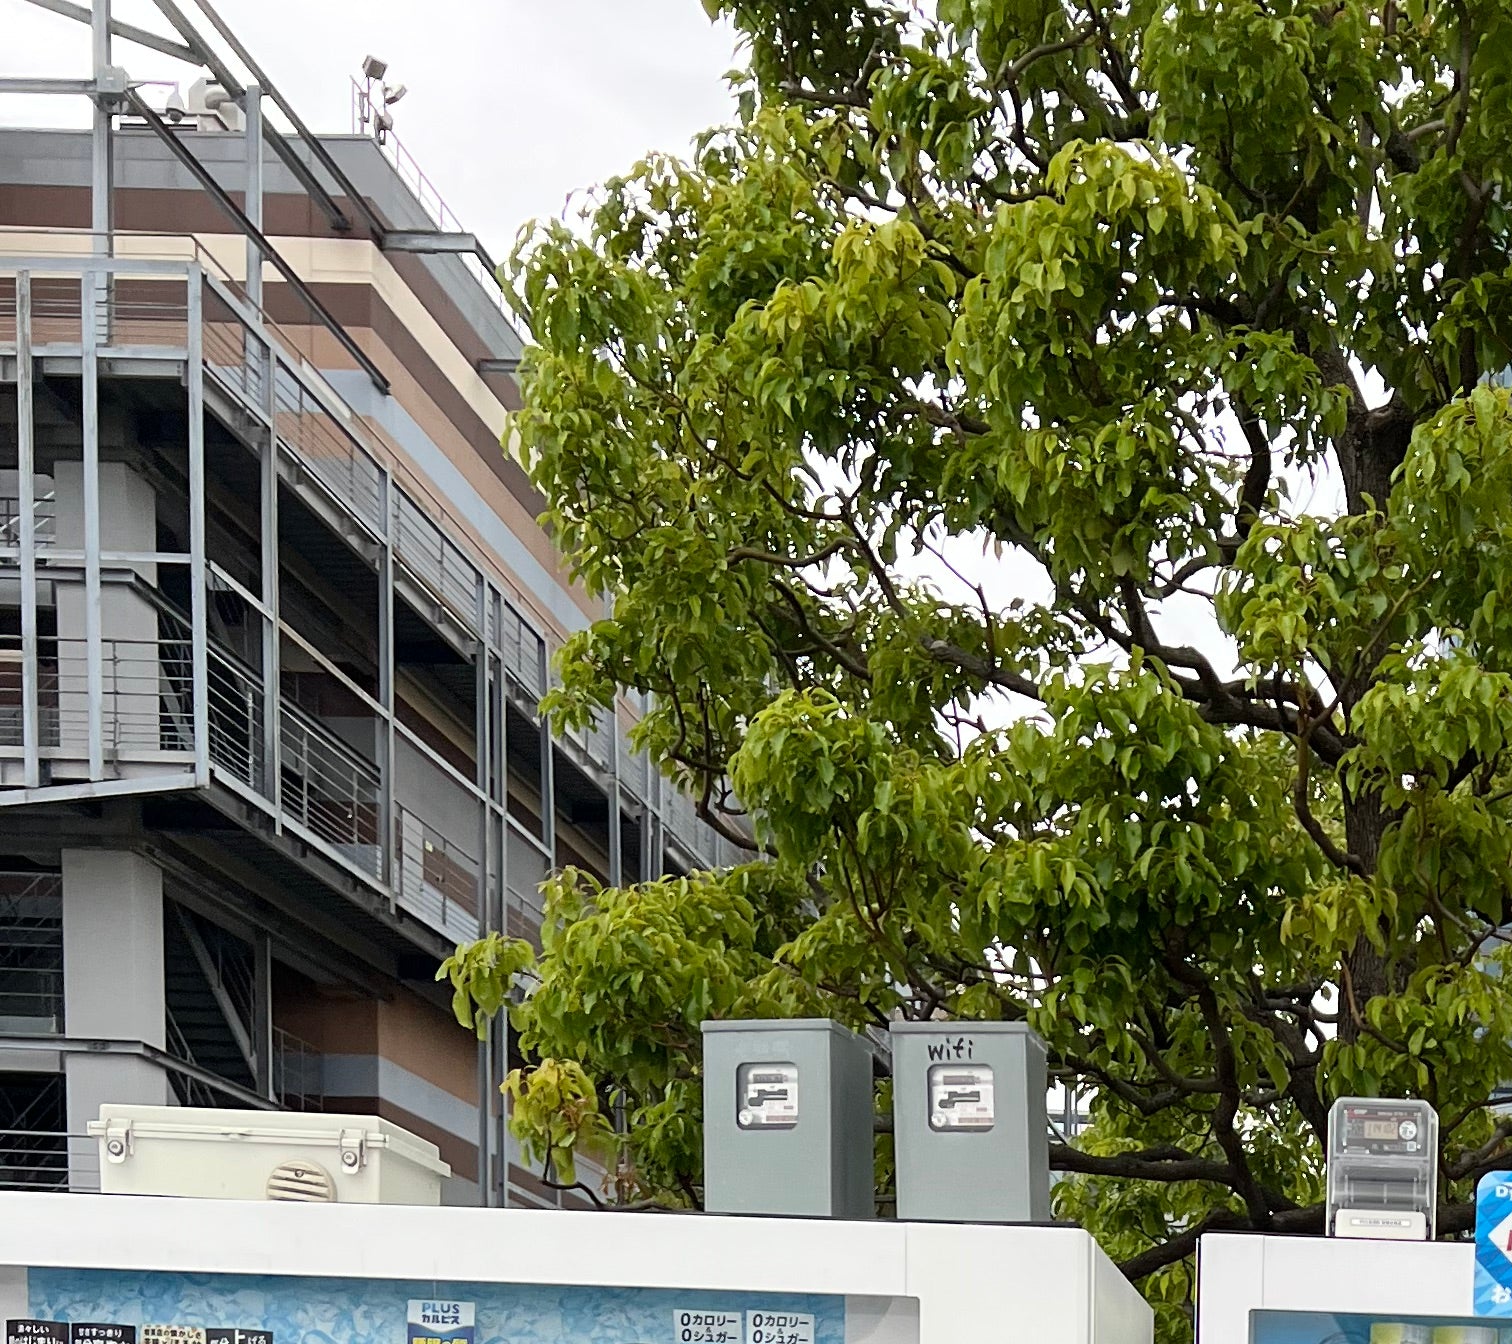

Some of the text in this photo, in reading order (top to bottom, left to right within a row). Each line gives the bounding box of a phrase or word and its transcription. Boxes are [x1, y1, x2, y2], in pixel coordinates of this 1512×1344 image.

[422, 1302, 460, 1314] PLUS
[422, 1314, 460, 1325] カルピス
[681, 1312, 737, 1327] 0カロリー
[752, 1313, 809, 1328] 0カロリー
[681, 1328, 738, 1344] 0シュガー
